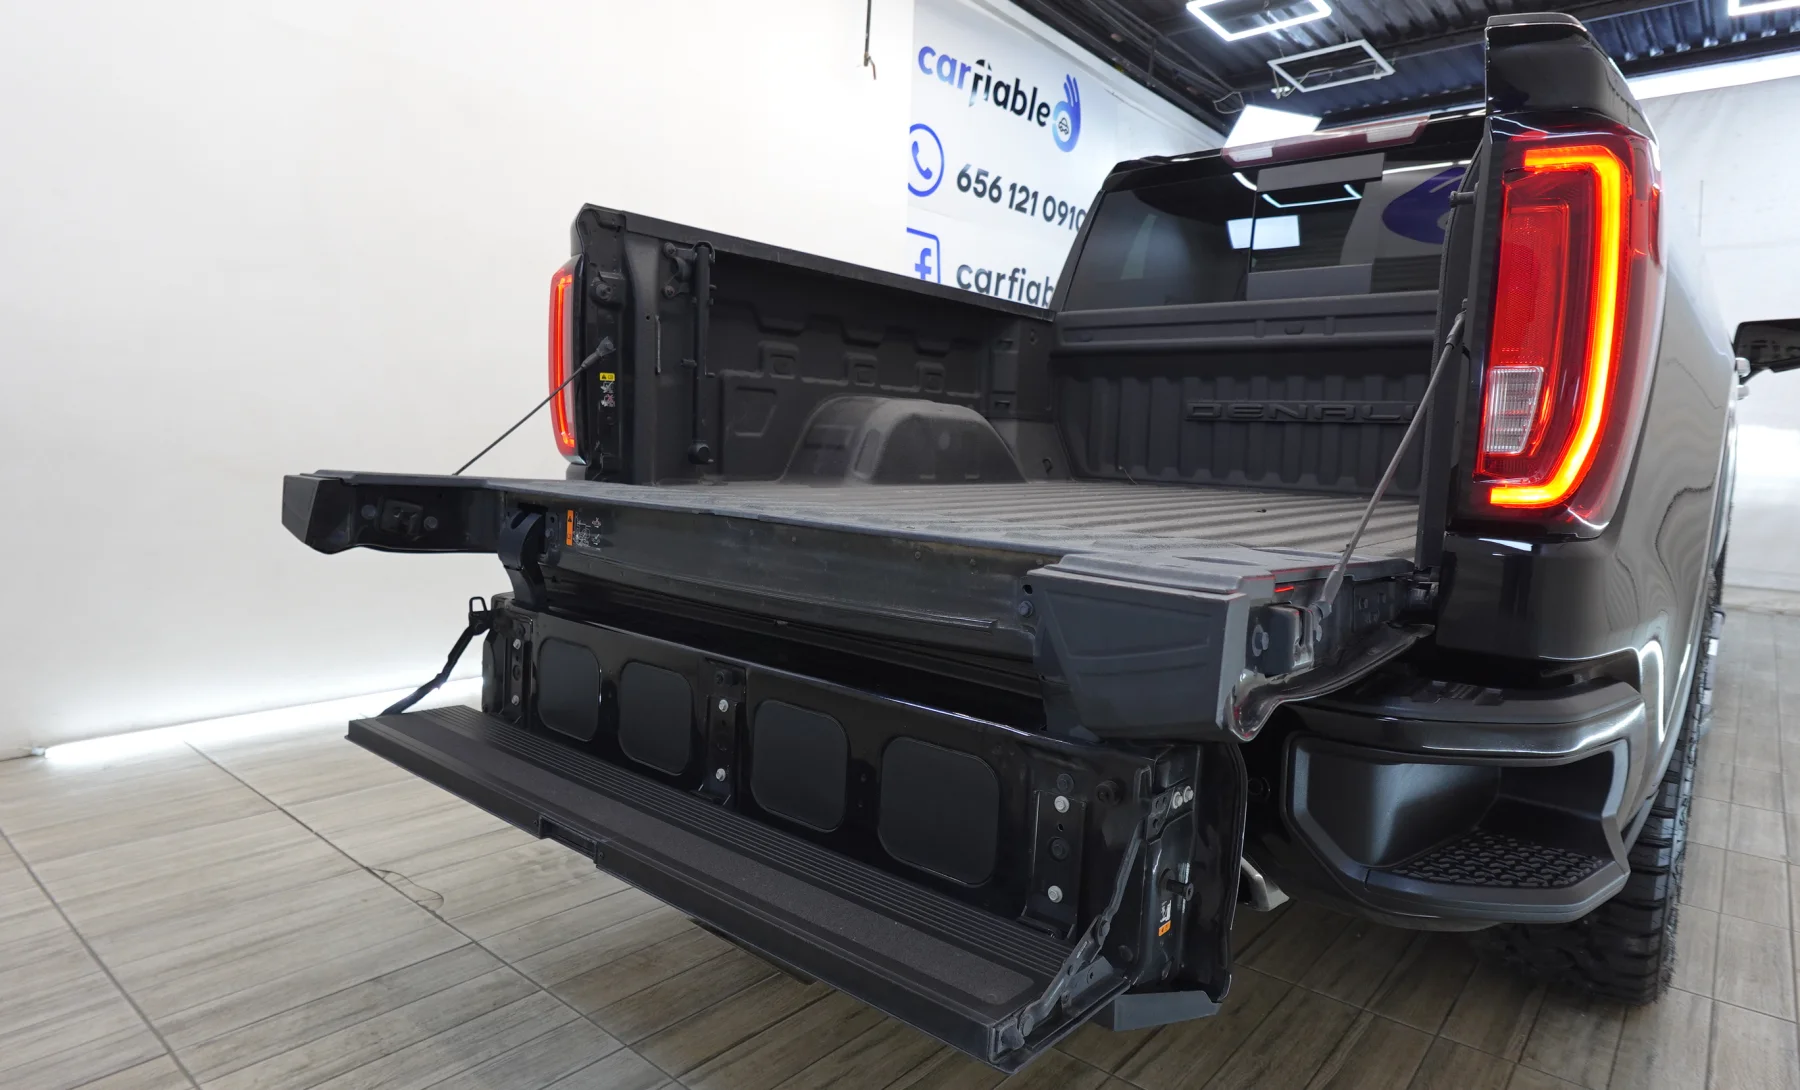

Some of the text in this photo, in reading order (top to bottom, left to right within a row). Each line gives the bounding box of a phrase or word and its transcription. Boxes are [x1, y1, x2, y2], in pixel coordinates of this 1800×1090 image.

[918, 46, 1051, 127] carfiable
[957, 164, 1002, 203] 656
[1008, 182, 1039, 217] 121
